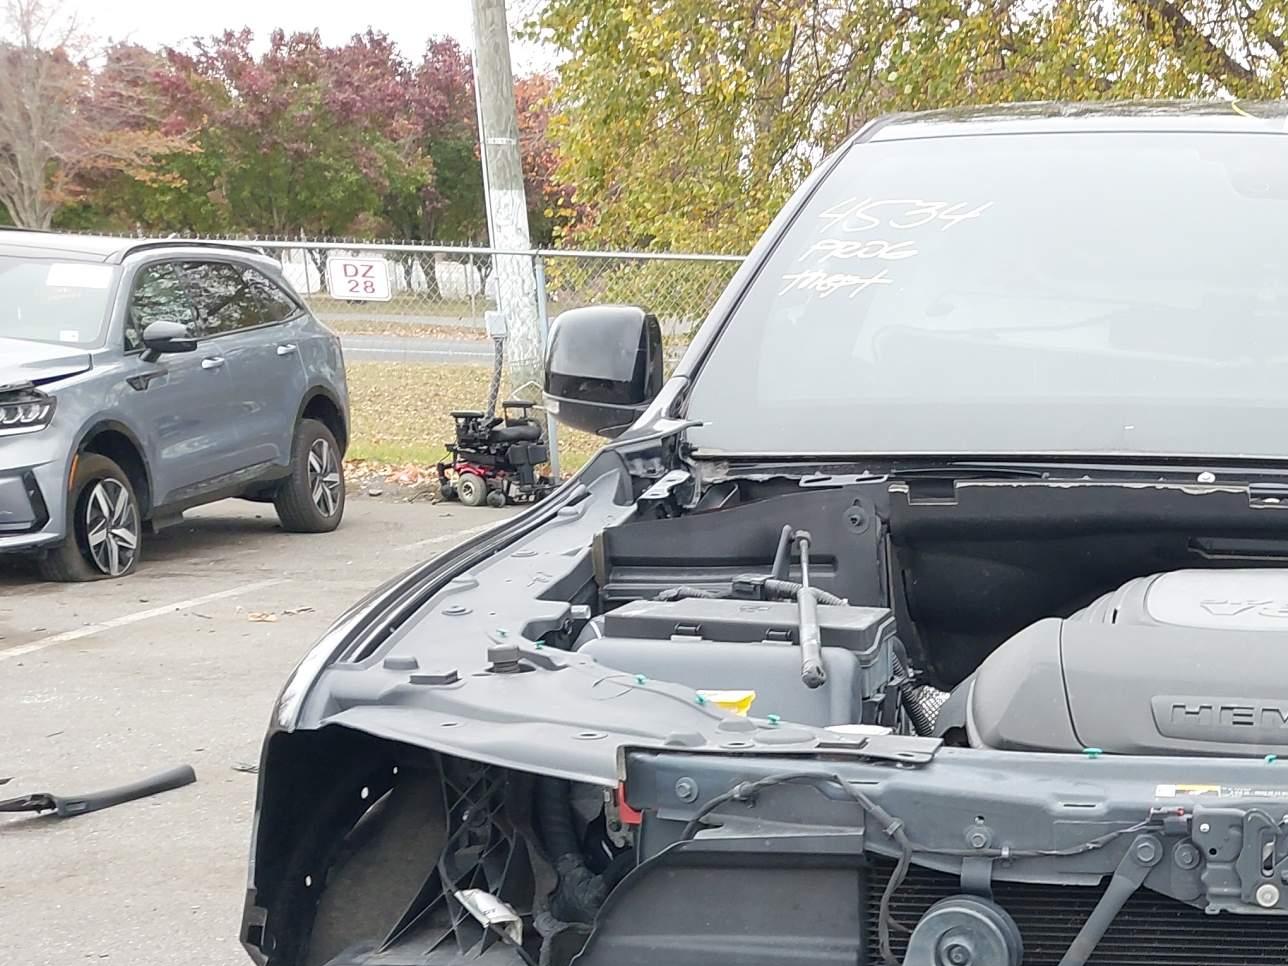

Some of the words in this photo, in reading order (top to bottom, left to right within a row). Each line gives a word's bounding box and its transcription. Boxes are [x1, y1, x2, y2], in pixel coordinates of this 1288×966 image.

[820, 196, 994, 233] 4534
[343, 263, 376, 279] DZ
[347, 279, 376, 294] 28
